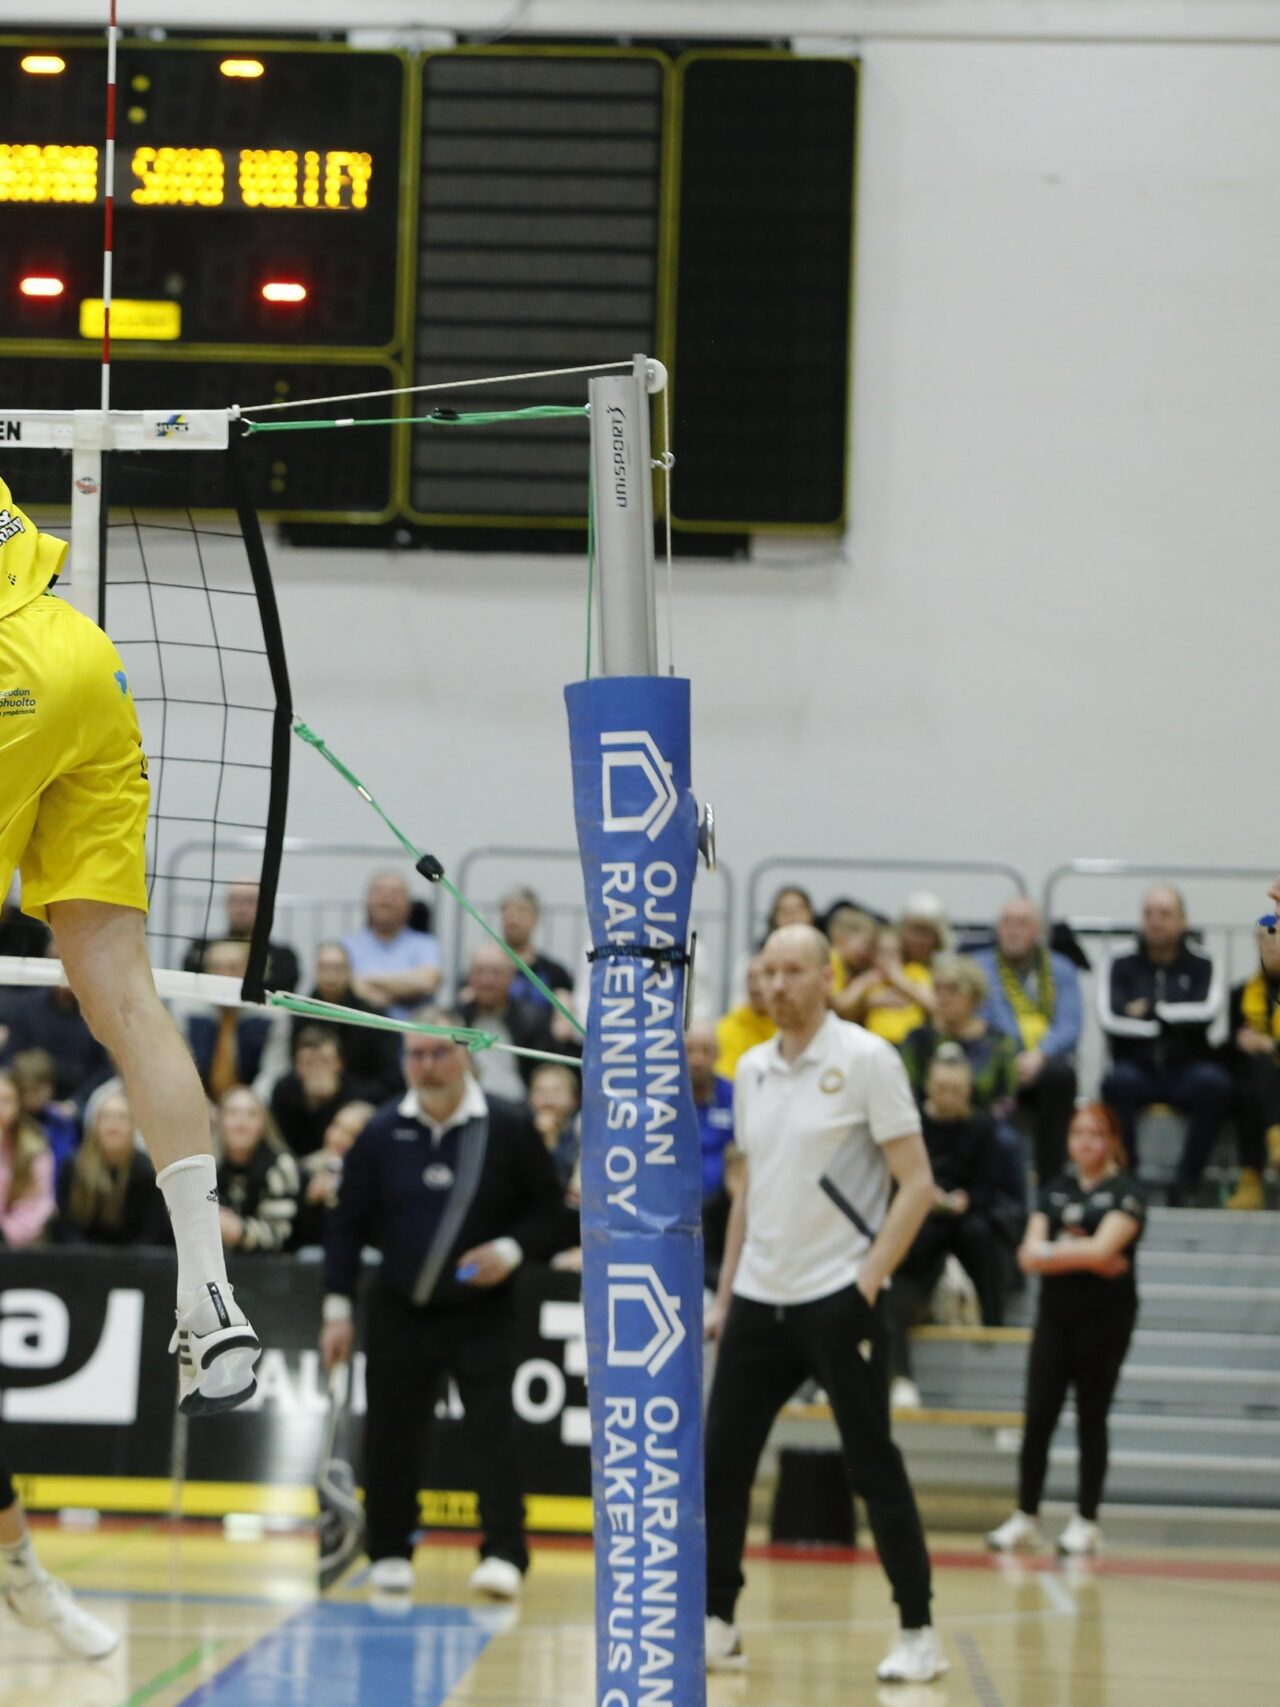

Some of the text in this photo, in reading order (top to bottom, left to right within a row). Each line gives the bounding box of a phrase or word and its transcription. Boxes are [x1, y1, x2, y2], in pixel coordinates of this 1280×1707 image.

[600, 862, 638, 1216] RAKENNUS OY
[643, 861, 680, 1166] OJARANNAN
[604, 1397, 637, 1673] RAKENNUS
[637, 1396, 680, 1707] OJARANNAN
